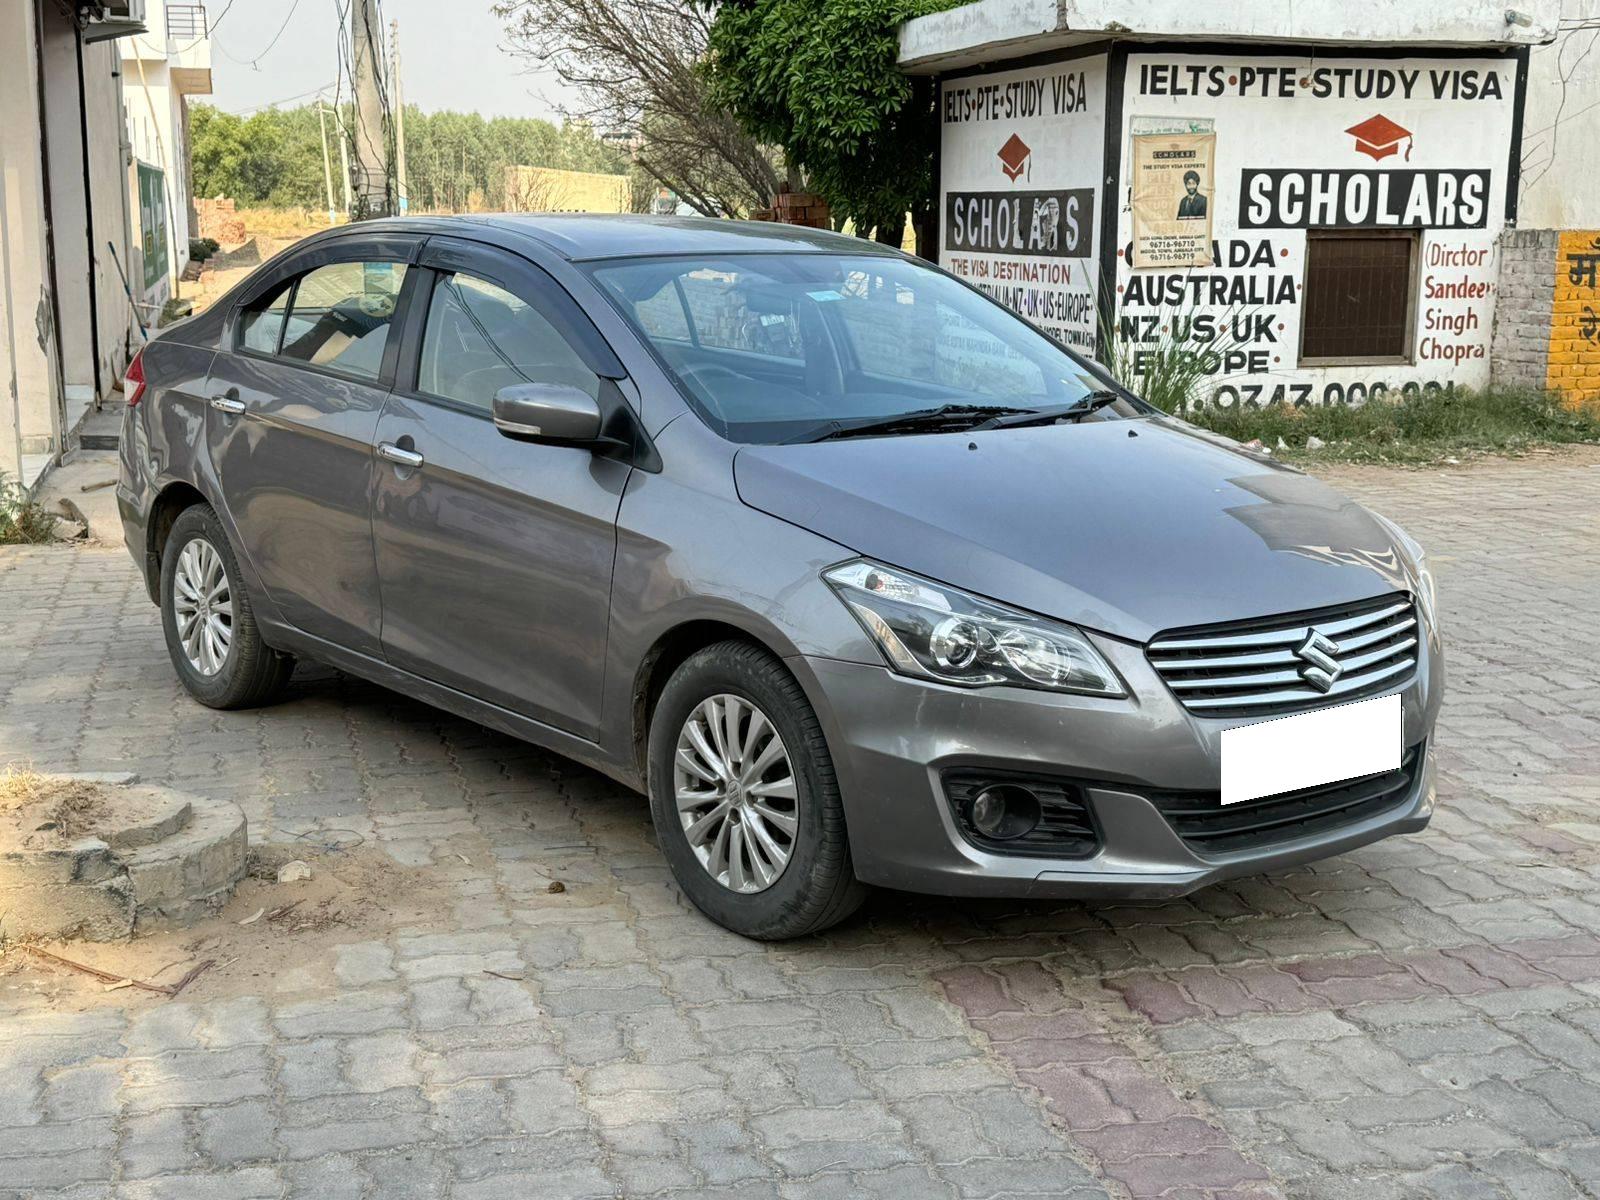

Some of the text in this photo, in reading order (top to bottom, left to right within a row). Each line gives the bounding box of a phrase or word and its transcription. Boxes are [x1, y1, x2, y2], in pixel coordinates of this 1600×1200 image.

[944, 72, 1087, 123] IELTS PTE STUDY VISA
[1139, 64, 1503, 100] IELTS PTE STUDY VISA
[1153, 151, 1196, 159] SCHOLARS
[1248, 173, 1484, 225] SCHOLARS
[954, 195, 1079, 251] SCHOLARS
[951, 258, 1071, 285] THE VISA DESTINATION
[1122, 274, 1296, 307] AUSTRALIA
[1057, 291, 1090, 324] EUROPE
[1425, 307, 1478, 336] Singh
[1231, 314, 1277, 343] UK
[1419, 338, 1485, 366] Chopra
